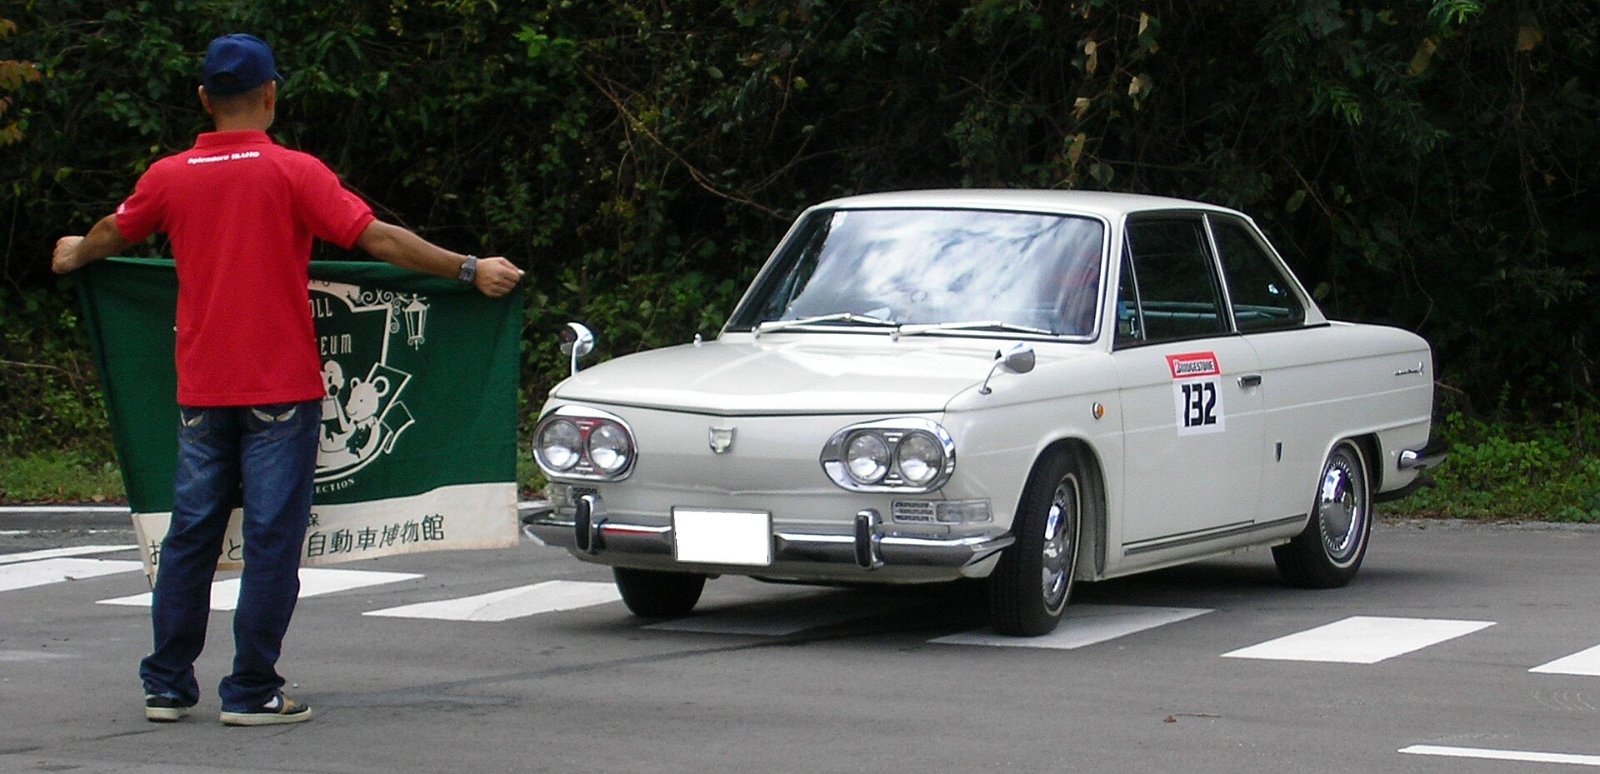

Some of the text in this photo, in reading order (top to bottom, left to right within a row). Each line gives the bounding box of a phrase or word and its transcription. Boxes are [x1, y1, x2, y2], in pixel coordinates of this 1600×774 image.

[317, 333, 352, 356] EUM
[1181, 382, 1217, 428] 132
[307, 512, 445, 558] 自動車博物館
